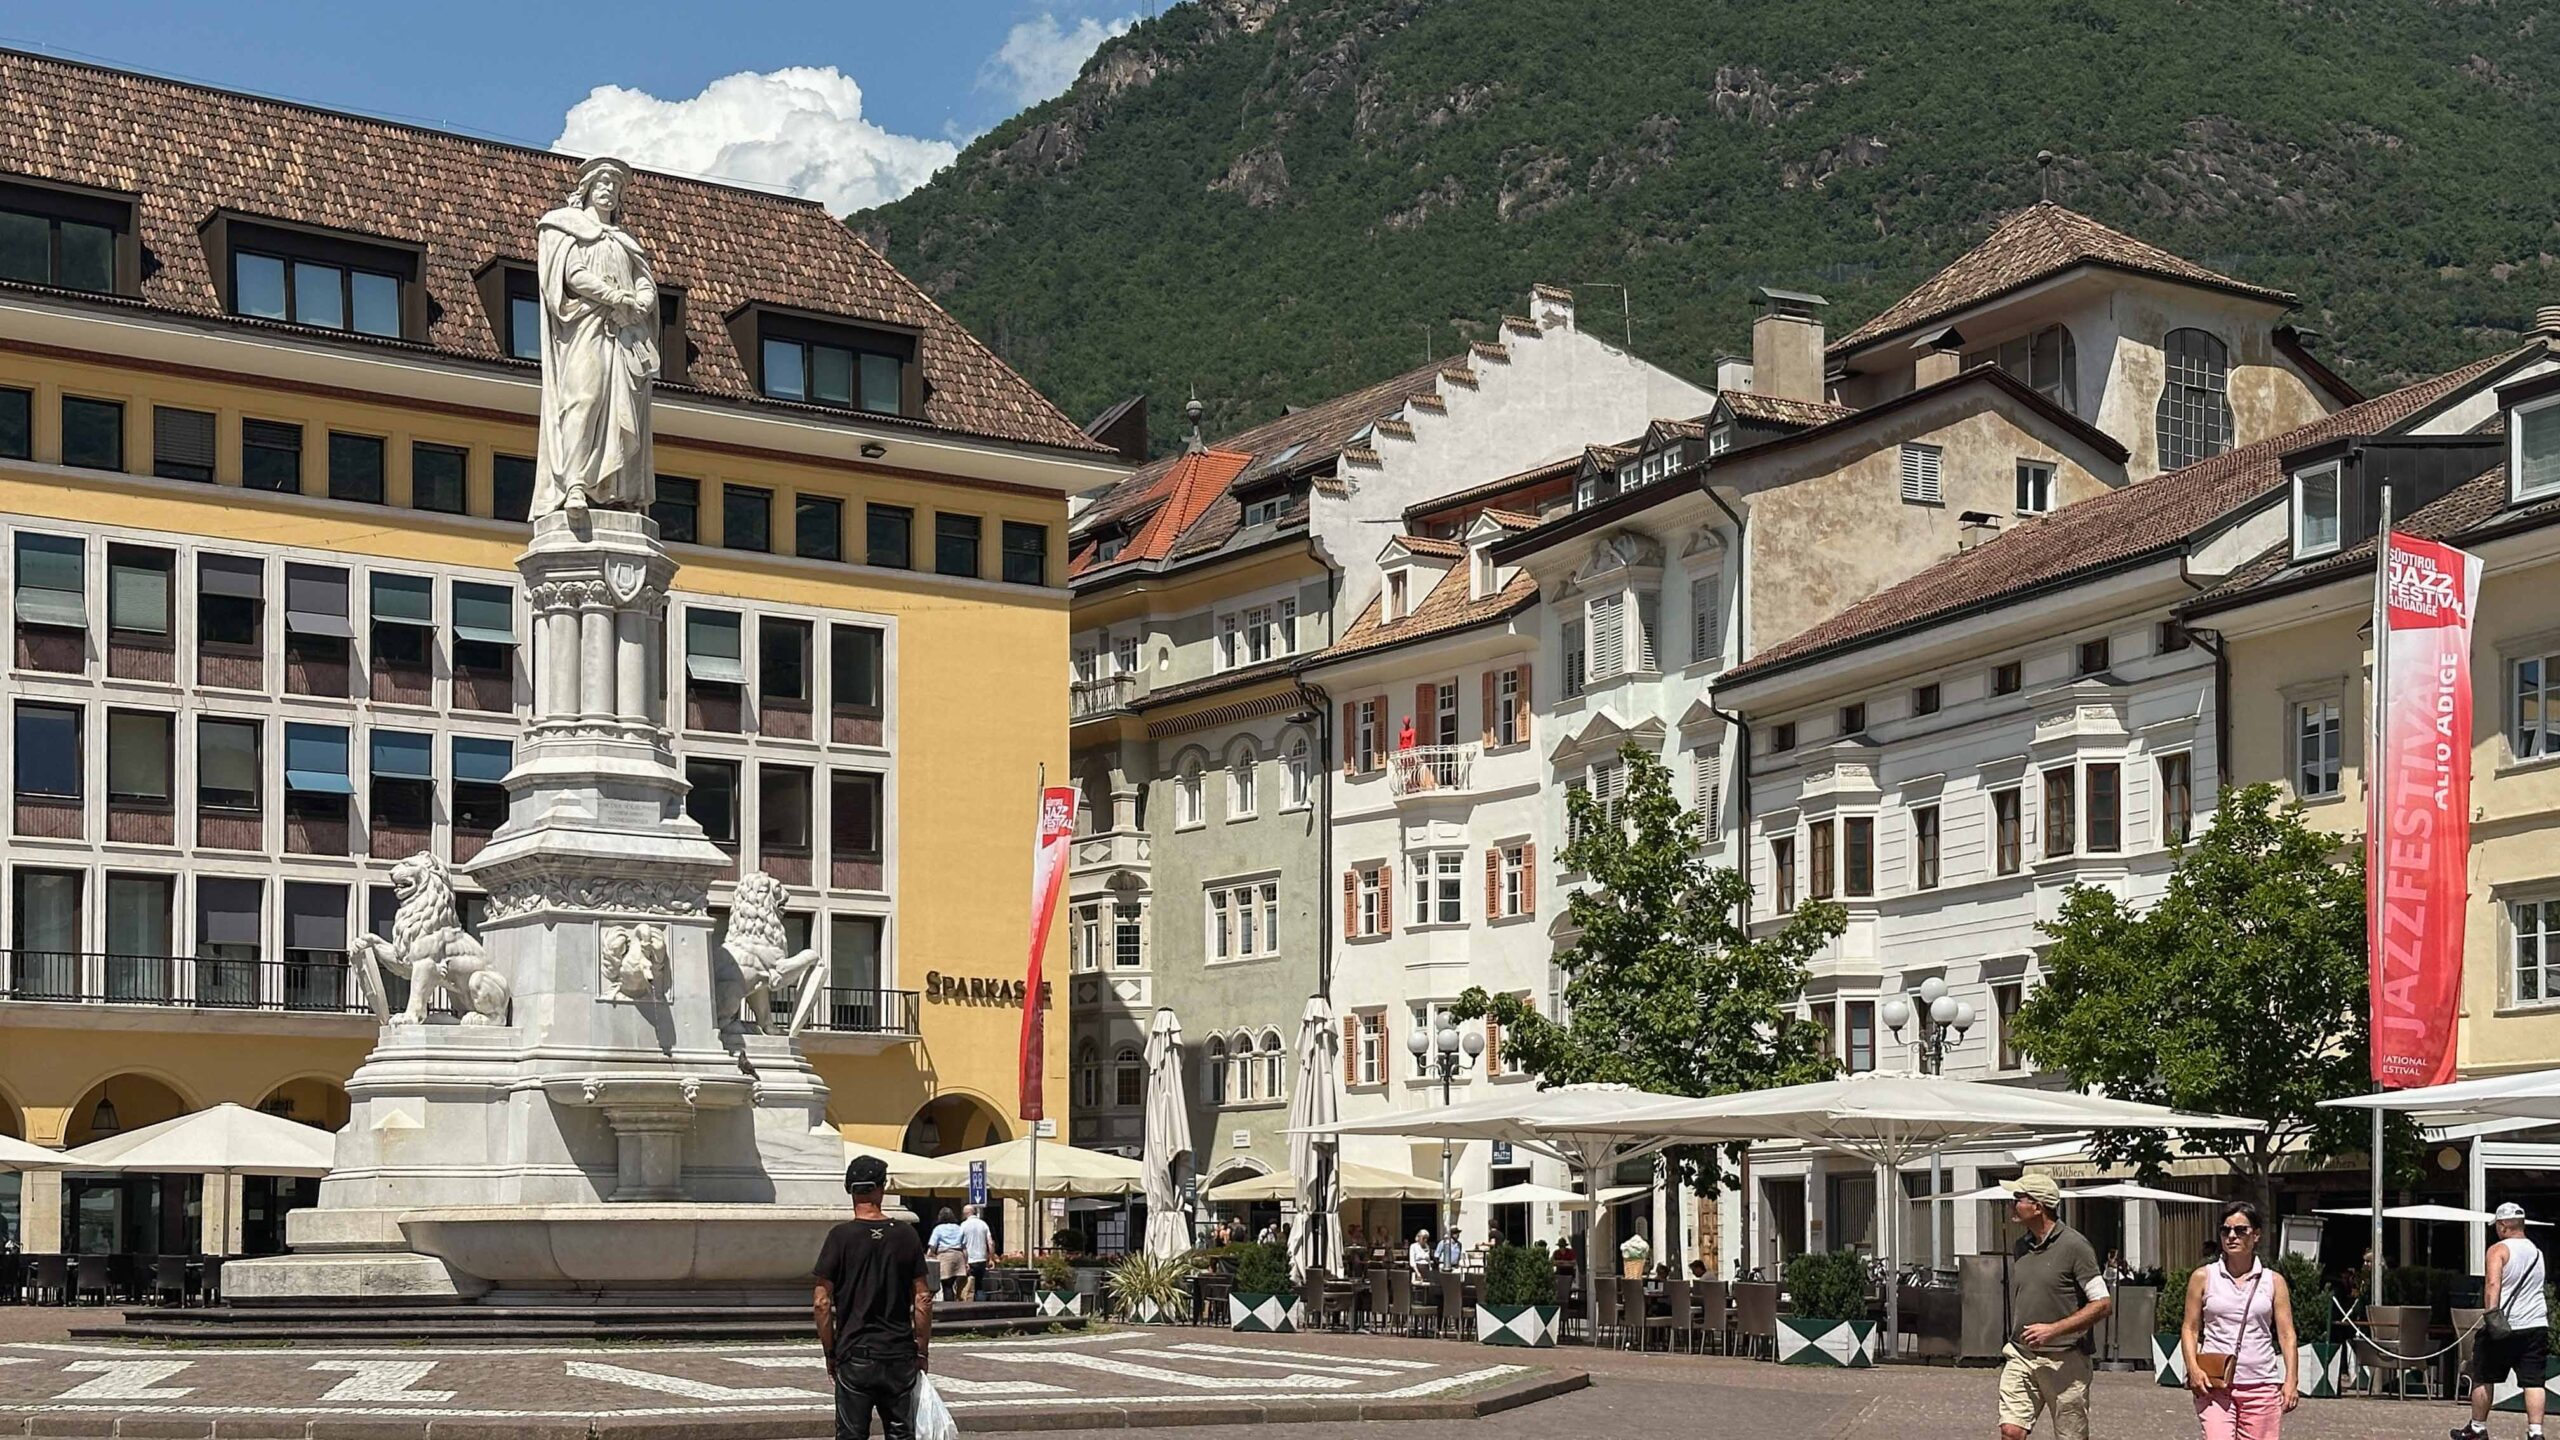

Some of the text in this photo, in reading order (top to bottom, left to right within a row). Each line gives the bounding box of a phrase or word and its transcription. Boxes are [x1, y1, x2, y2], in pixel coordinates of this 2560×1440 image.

[2390, 547, 2437, 571] SÜDTIROL
[2389, 561, 2453, 593] JAZZ
[2436, 652, 2458, 736] ADIGE
[926, 970, 1051, 1002] SPARKASE
[2383, 1064, 2421, 1076] ESTIVAL
[972, 1162, 983, 1172] WC
